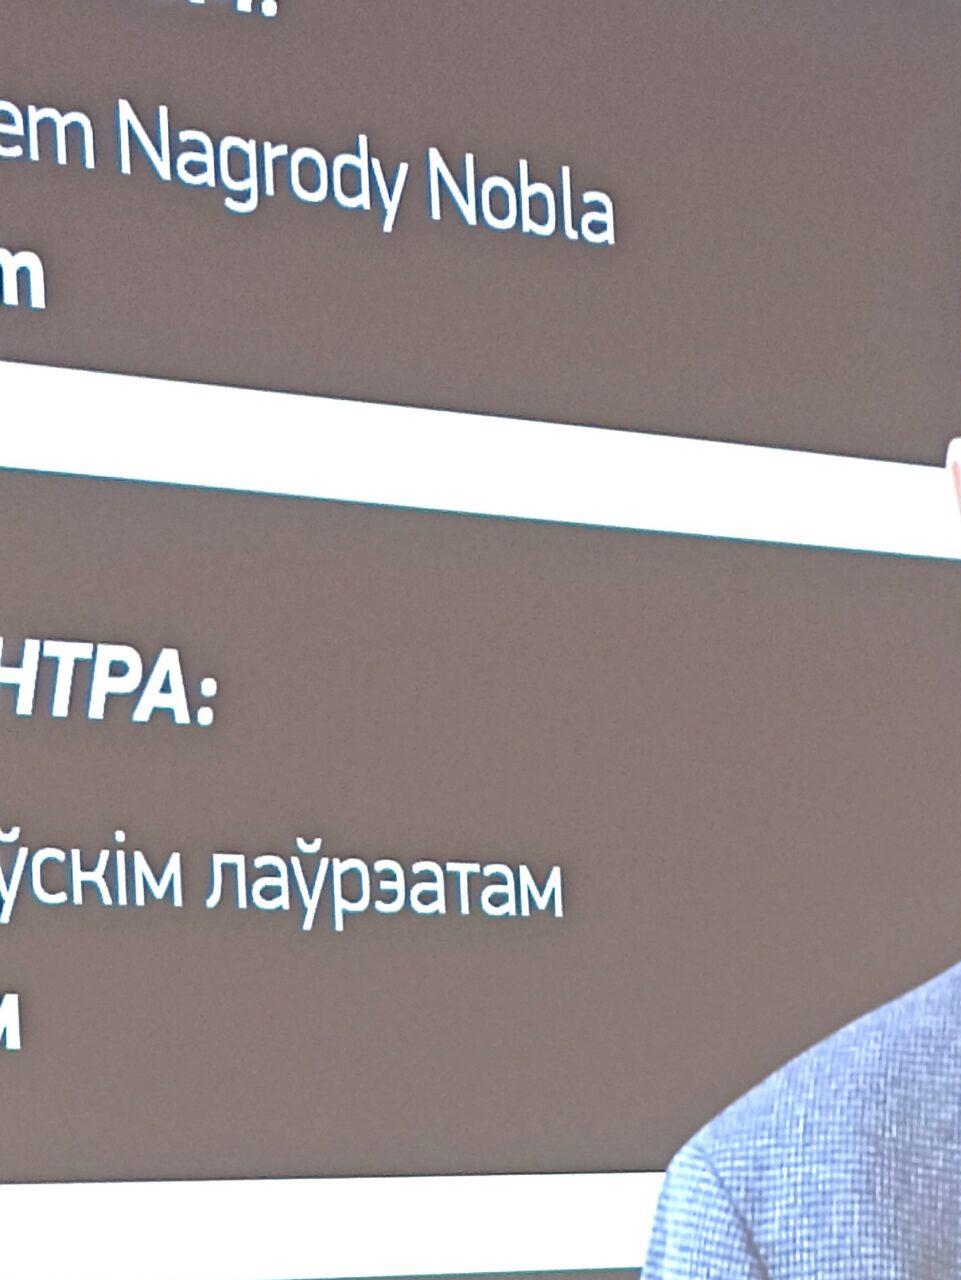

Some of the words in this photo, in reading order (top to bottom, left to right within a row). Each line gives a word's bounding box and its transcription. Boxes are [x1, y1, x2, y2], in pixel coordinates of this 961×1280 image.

[118, 98, 409, 233] Nagrody
[428, 147, 615, 245] Nobla
[206, 837, 563, 931] лаўрэатам
